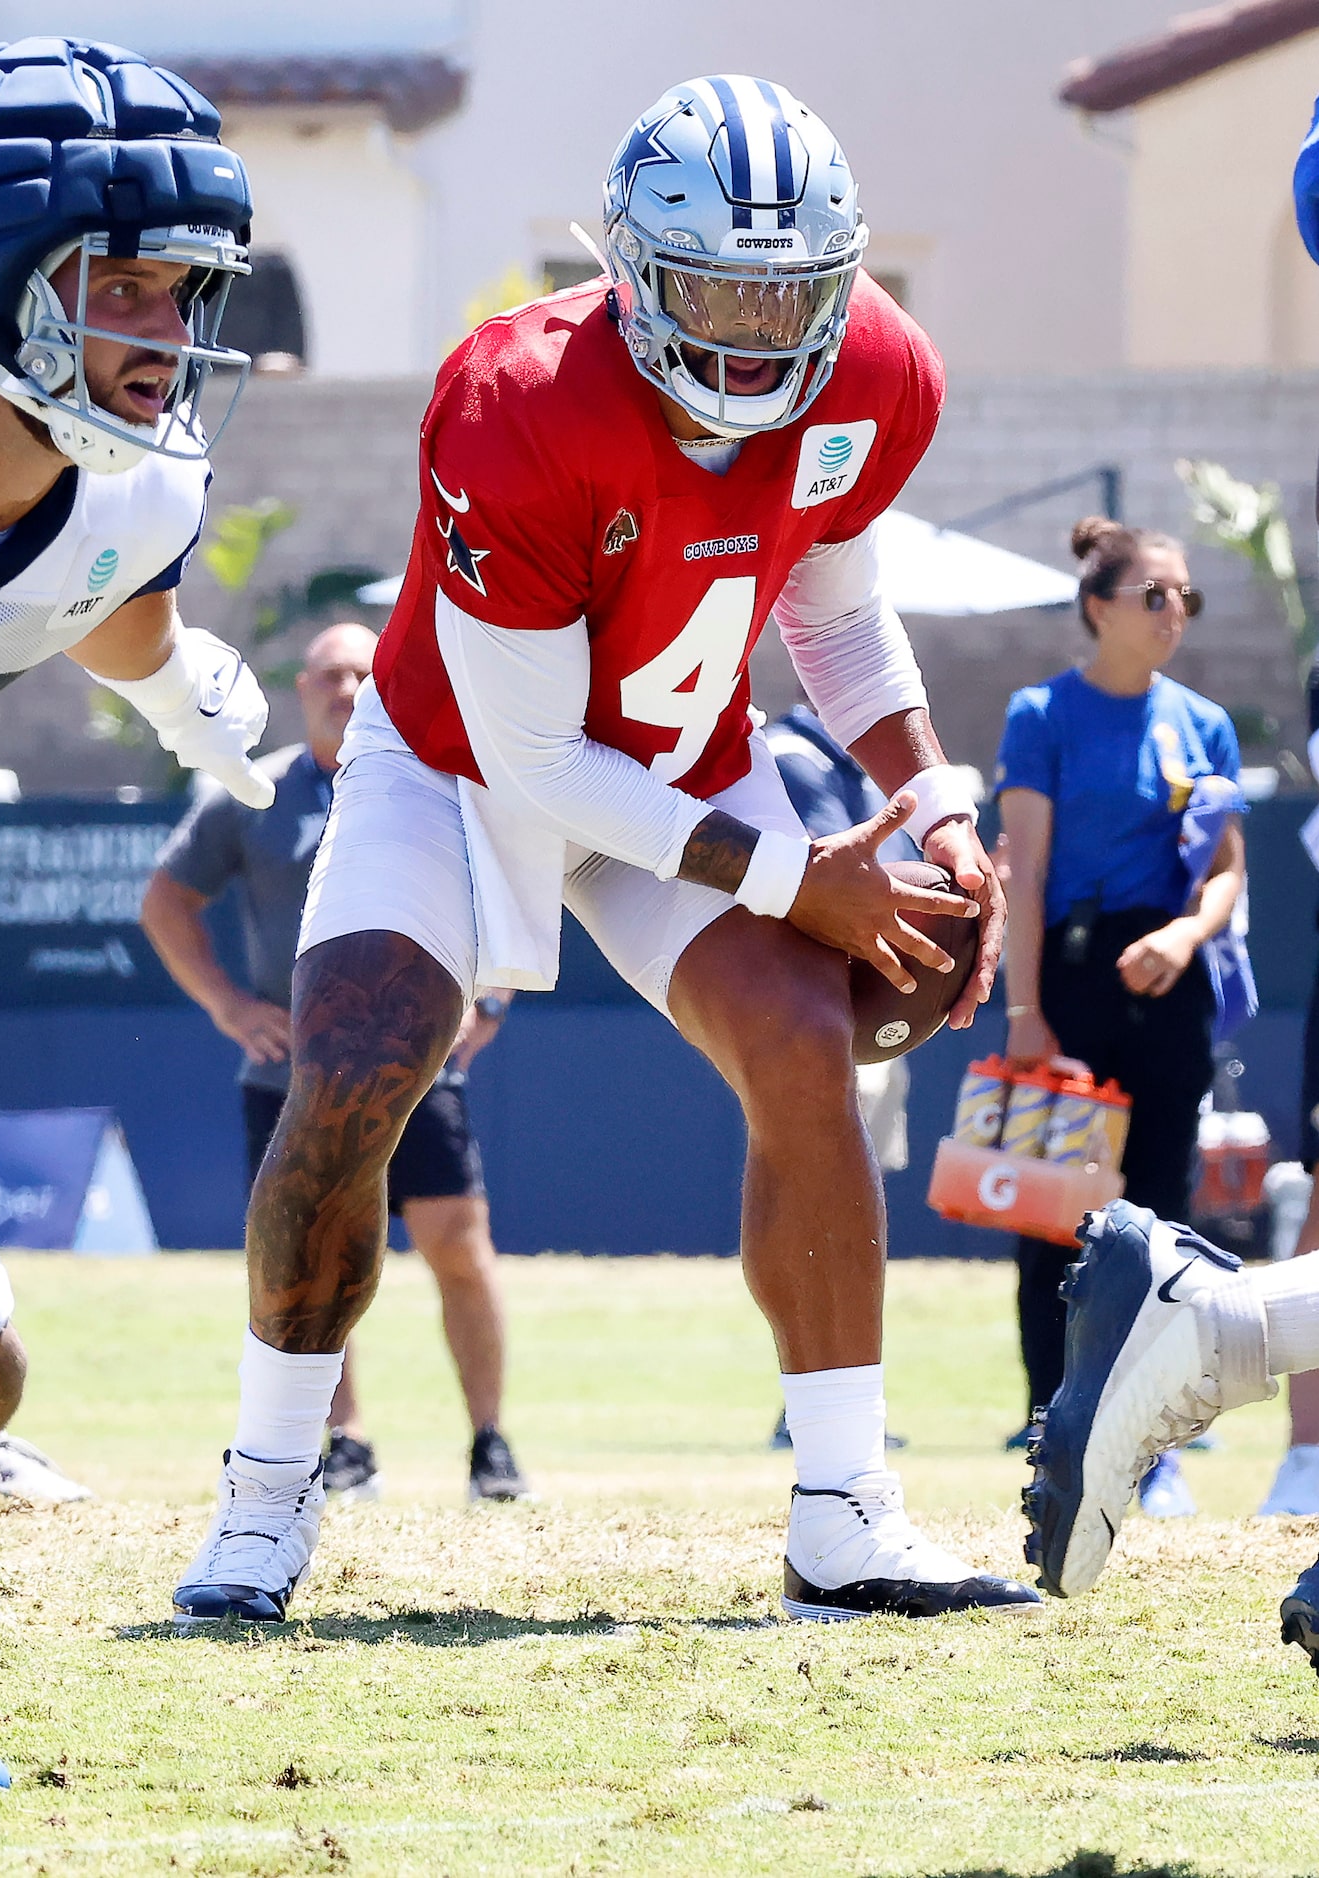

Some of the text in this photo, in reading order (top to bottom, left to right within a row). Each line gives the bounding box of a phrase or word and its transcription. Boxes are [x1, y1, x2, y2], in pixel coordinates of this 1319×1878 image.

[736, 237, 793, 249] COWBOYS
[806, 474, 848, 498] AT&T
[683, 534, 759, 561] COWBOYS
[63, 597, 105, 618] AT&T
[619, 575, 757, 786] 4
[977, 1163, 1020, 1211] G
